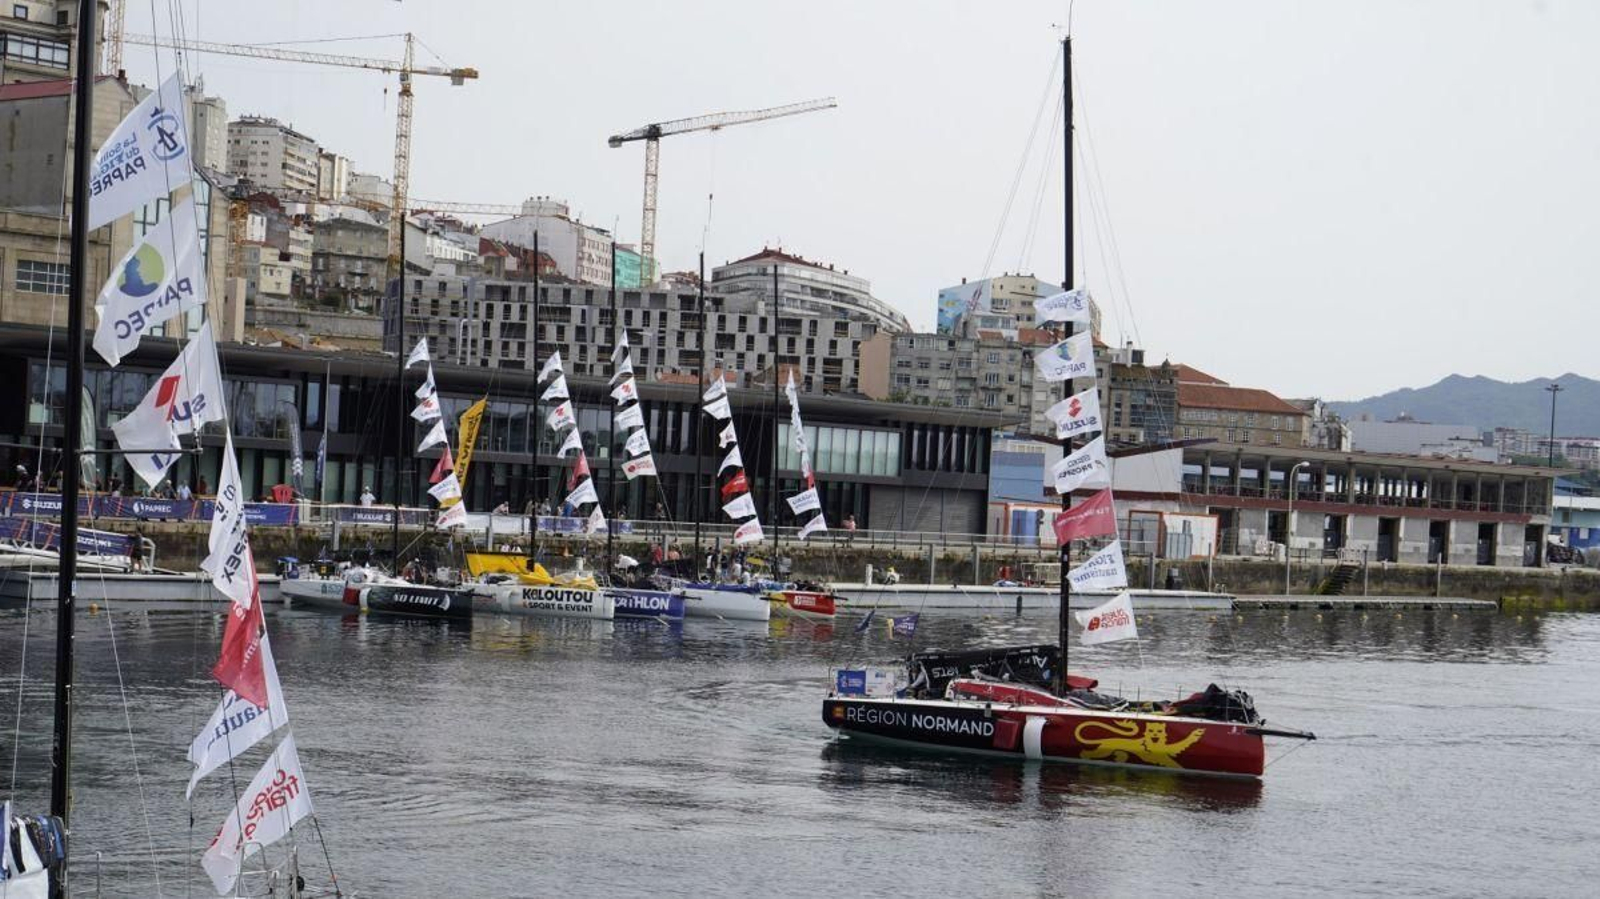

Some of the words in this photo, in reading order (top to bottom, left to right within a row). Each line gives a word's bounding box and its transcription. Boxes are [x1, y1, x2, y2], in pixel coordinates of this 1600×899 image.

[33, 500, 62, 510] SUZU
[144, 504, 172, 513] PAPREC
[614, 595, 670, 610] CATHLON
[565, 603, 593, 613] EVENT
[846, 704, 907, 727] RÉGION
[911, 714, 995, 737] NORMAND
